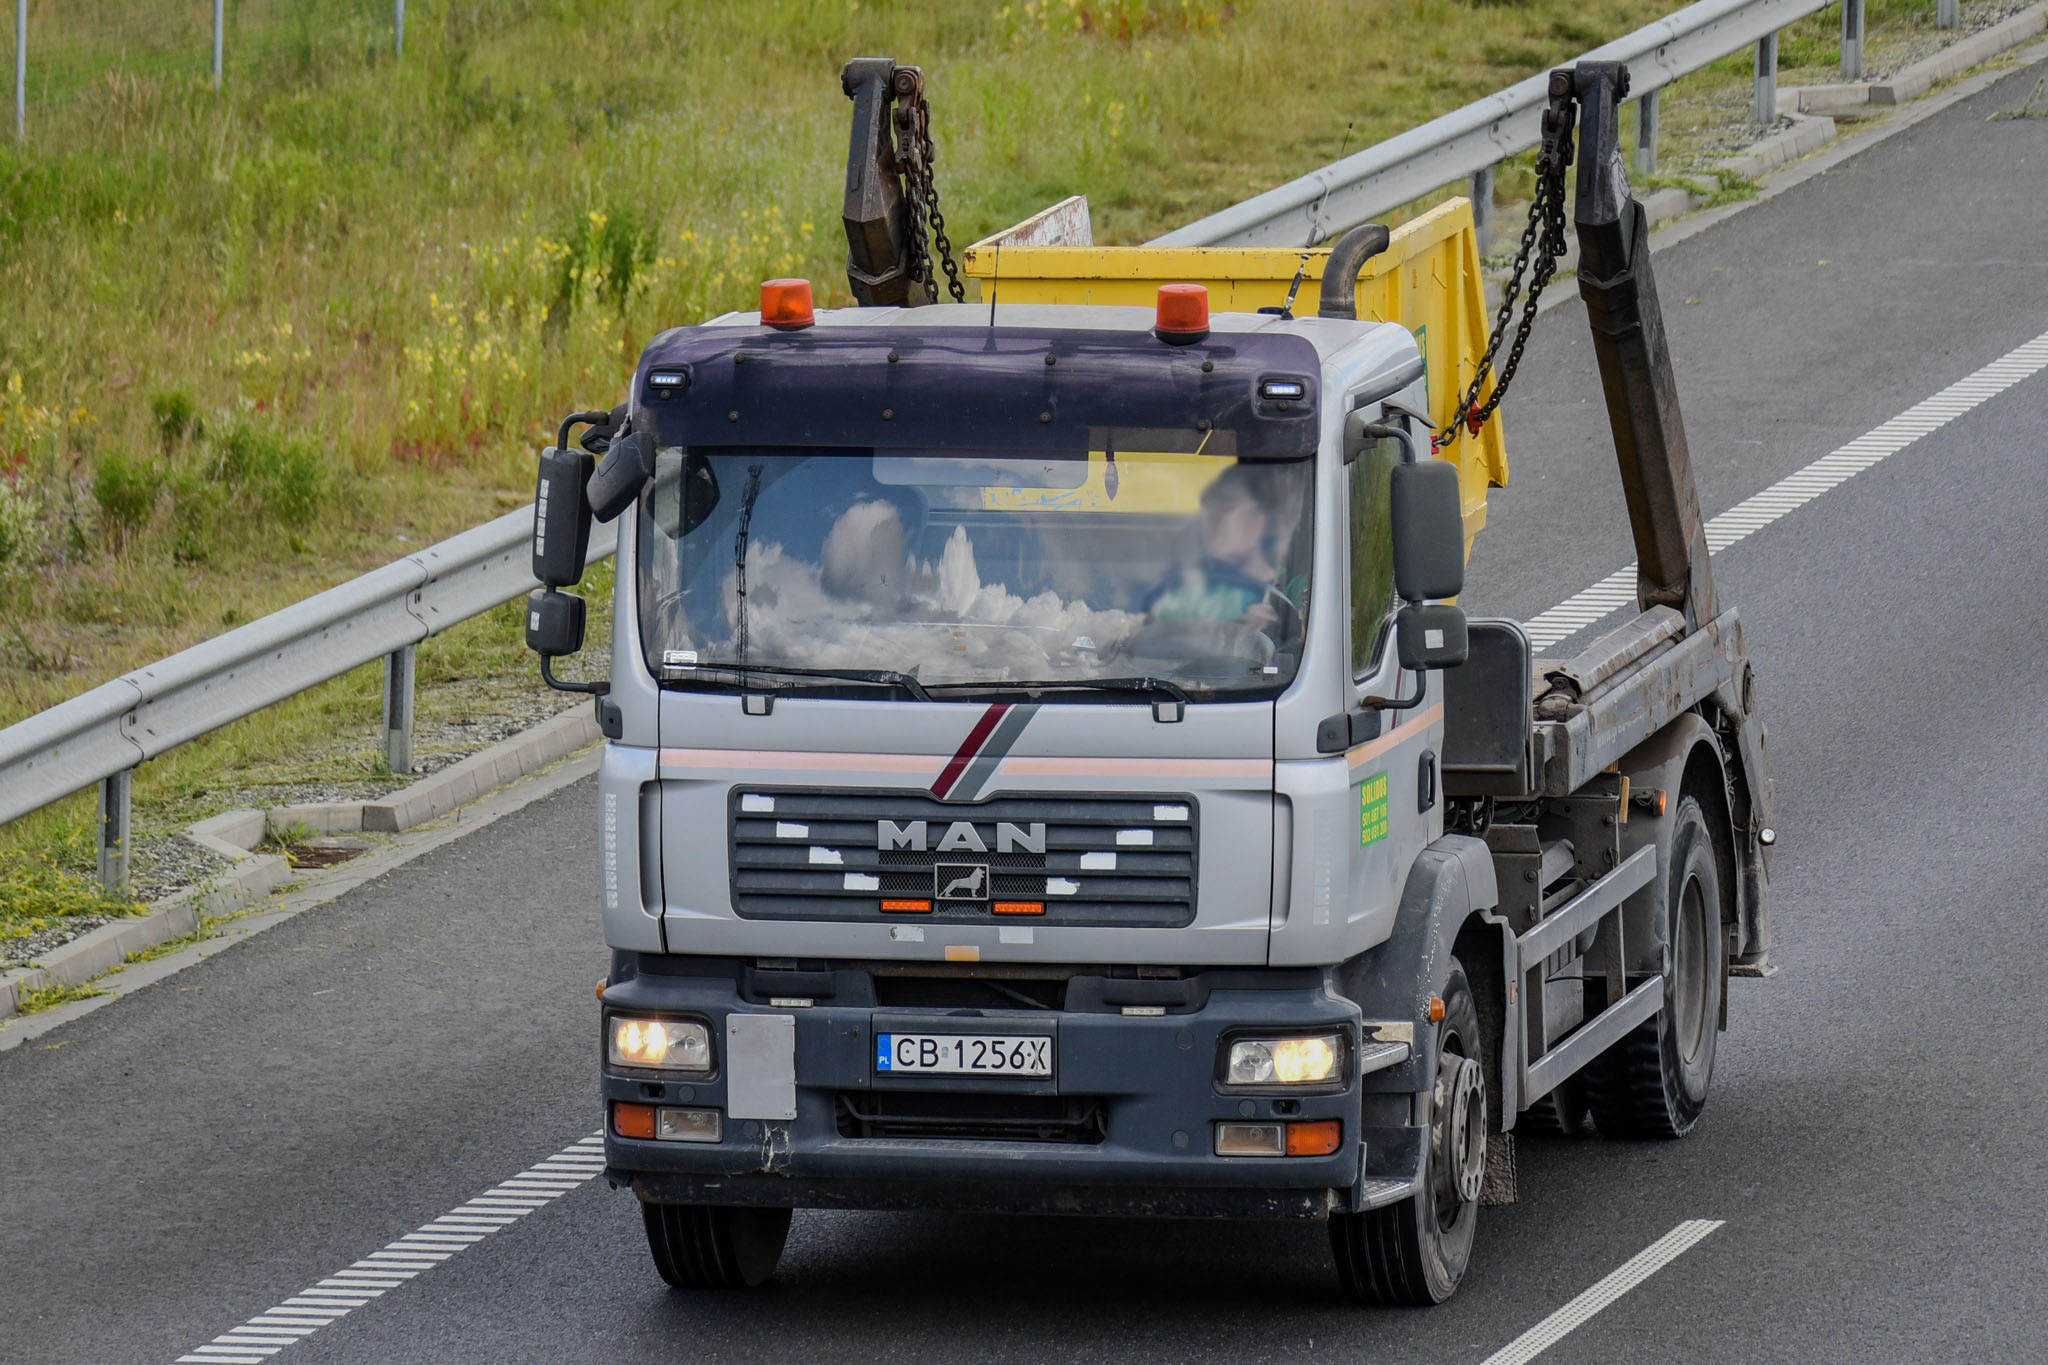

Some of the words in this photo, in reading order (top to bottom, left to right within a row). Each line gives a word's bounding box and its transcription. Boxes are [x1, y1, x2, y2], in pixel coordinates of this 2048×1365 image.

[878, 820, 1046, 853] MAN
[879, 1055, 890, 1065] PL
[897, 1038, 939, 1067] CB
[954, 1039, 1046, 1070] 1256X
